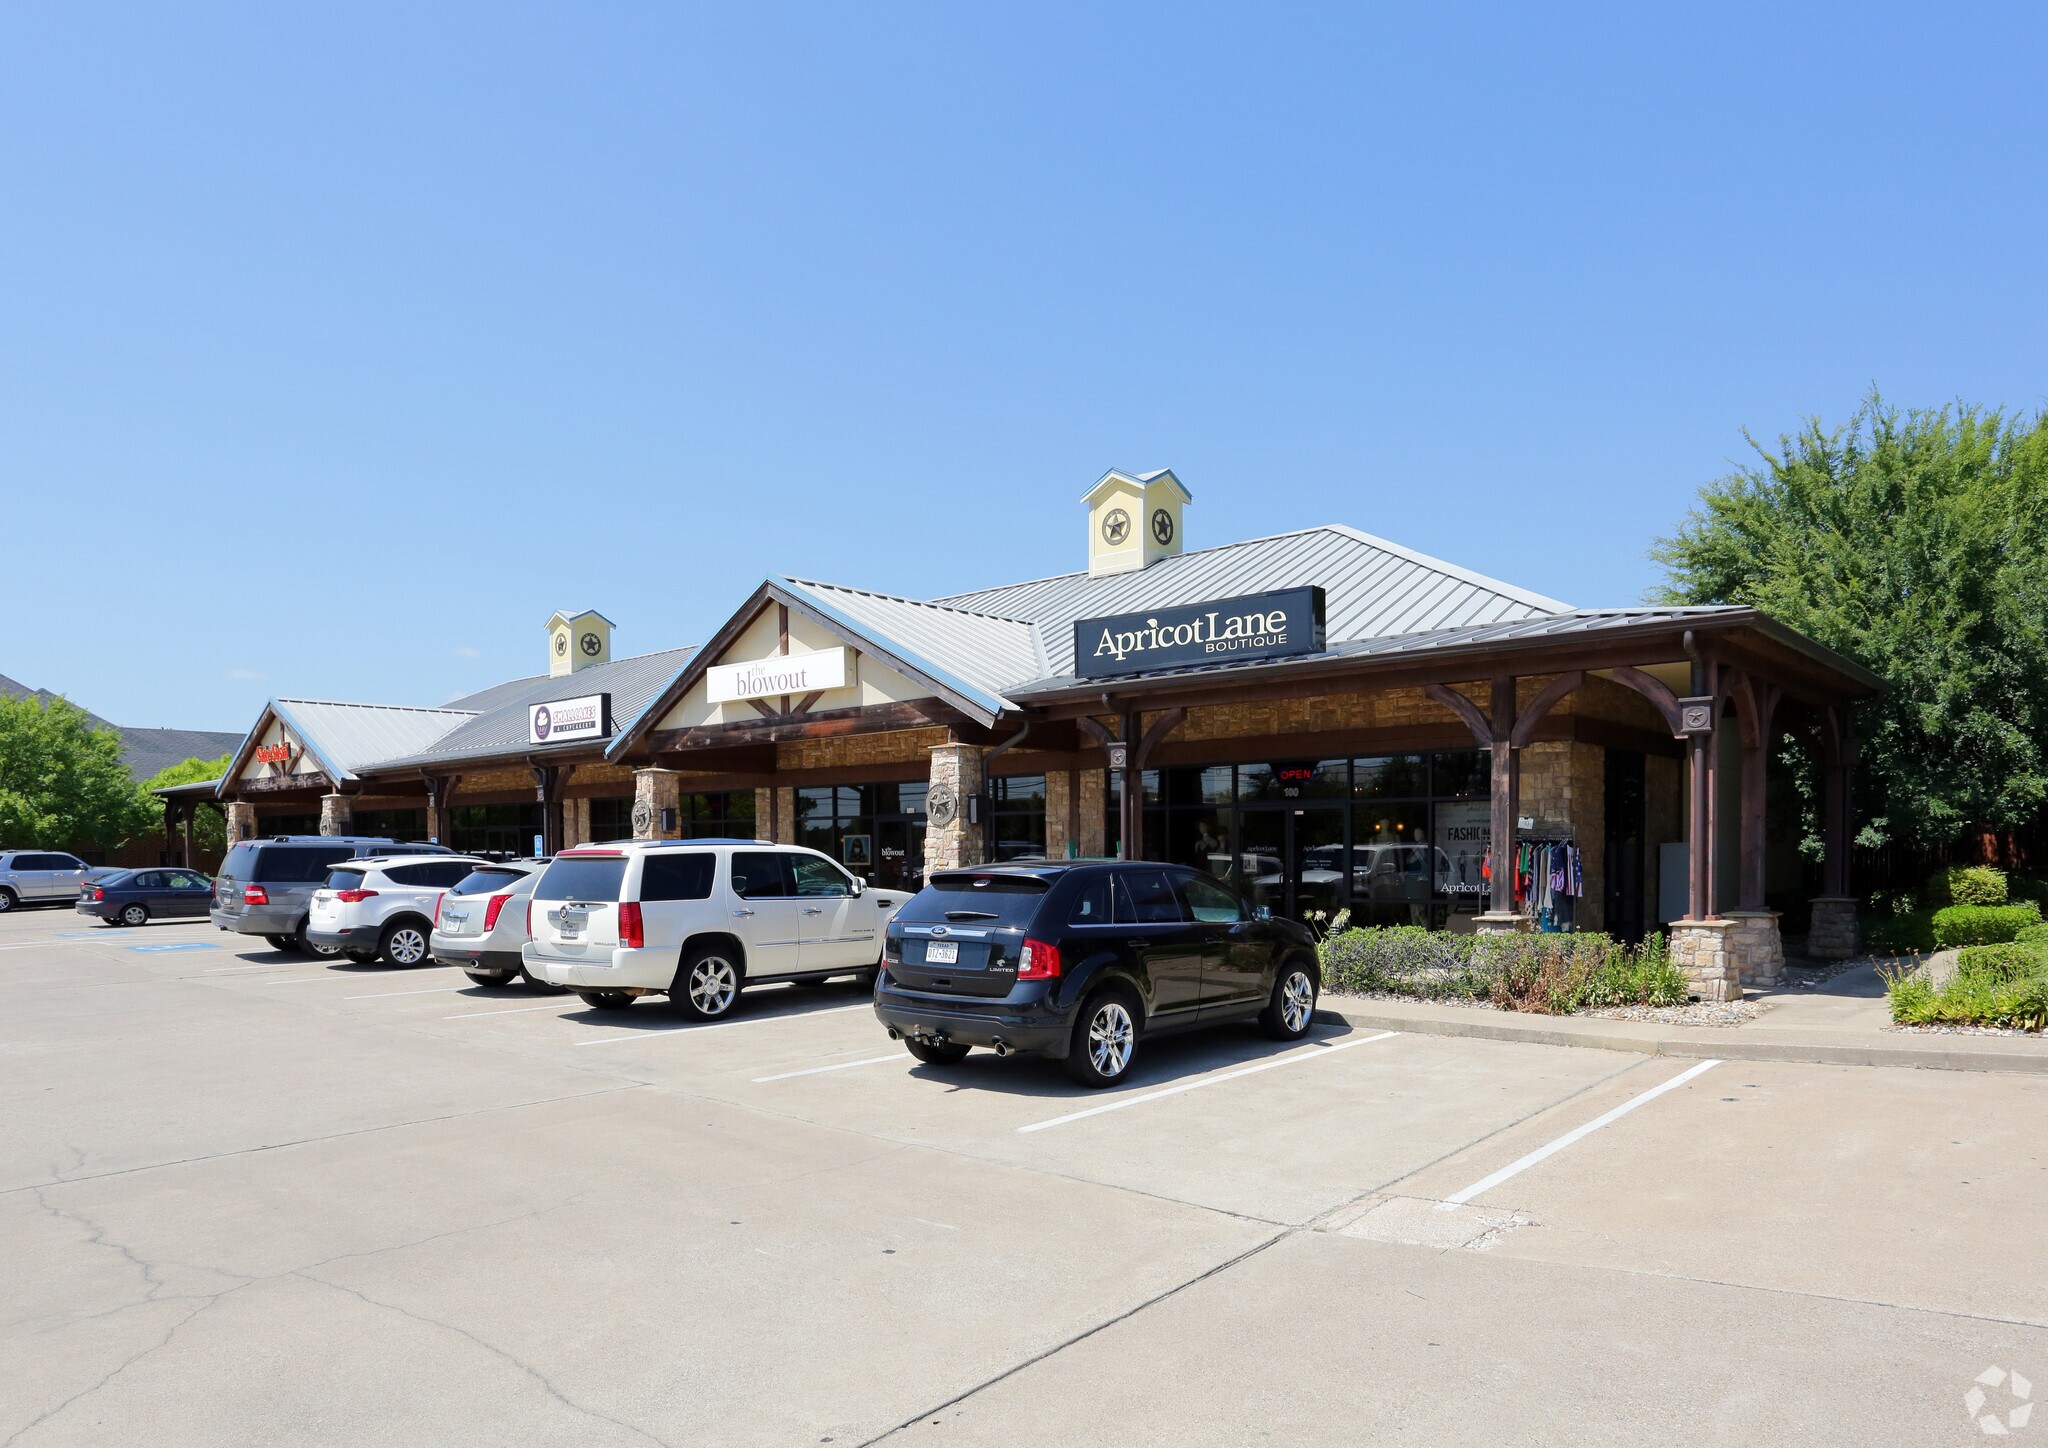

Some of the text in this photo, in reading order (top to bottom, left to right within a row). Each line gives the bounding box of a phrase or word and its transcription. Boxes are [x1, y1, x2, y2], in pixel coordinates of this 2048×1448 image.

[1205, 633, 1287, 653] BOUTIQUE
[751, 664, 766, 677] the
[736, 668, 808, 696] blowout
[1280, 769, 1311, 780] OPEN
[1284, 787, 1299, 797] 100
